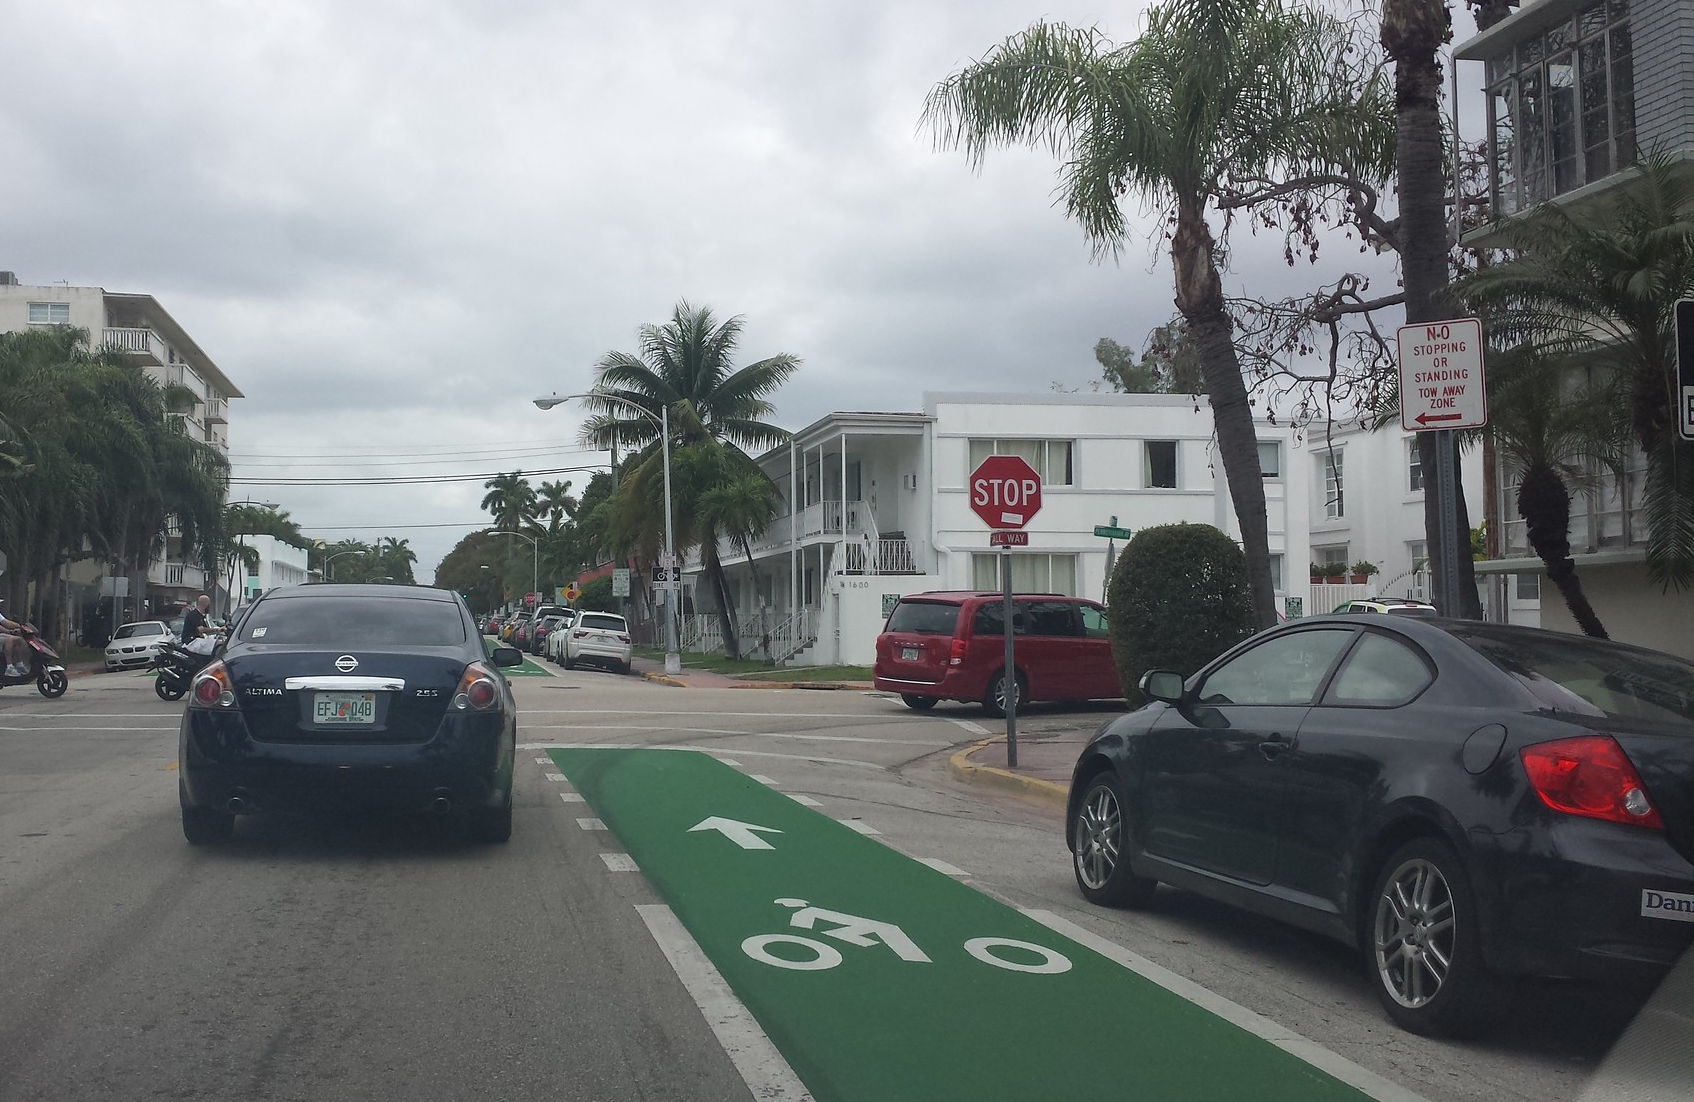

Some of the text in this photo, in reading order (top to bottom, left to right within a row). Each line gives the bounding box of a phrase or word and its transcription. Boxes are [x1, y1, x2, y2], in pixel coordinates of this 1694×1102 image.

[1426, 325, 1450, 341] NO
[1413, 341, 1467, 356] STOPPING
[1433, 357, 1448, 367] OR
[1414, 369, 1469, 383] STANDING
[1418, 384, 1466, 398] TOW AWAY
[1430, 397, 1456, 409] ZONE
[974, 478, 1037, 506] STOP
[991, 534, 1025, 544] ALL WAY
[848, 581, 869, 589] 1600
[245, 688, 283, 696] ALTIMA
[317, 701, 338, 716] EFJ
